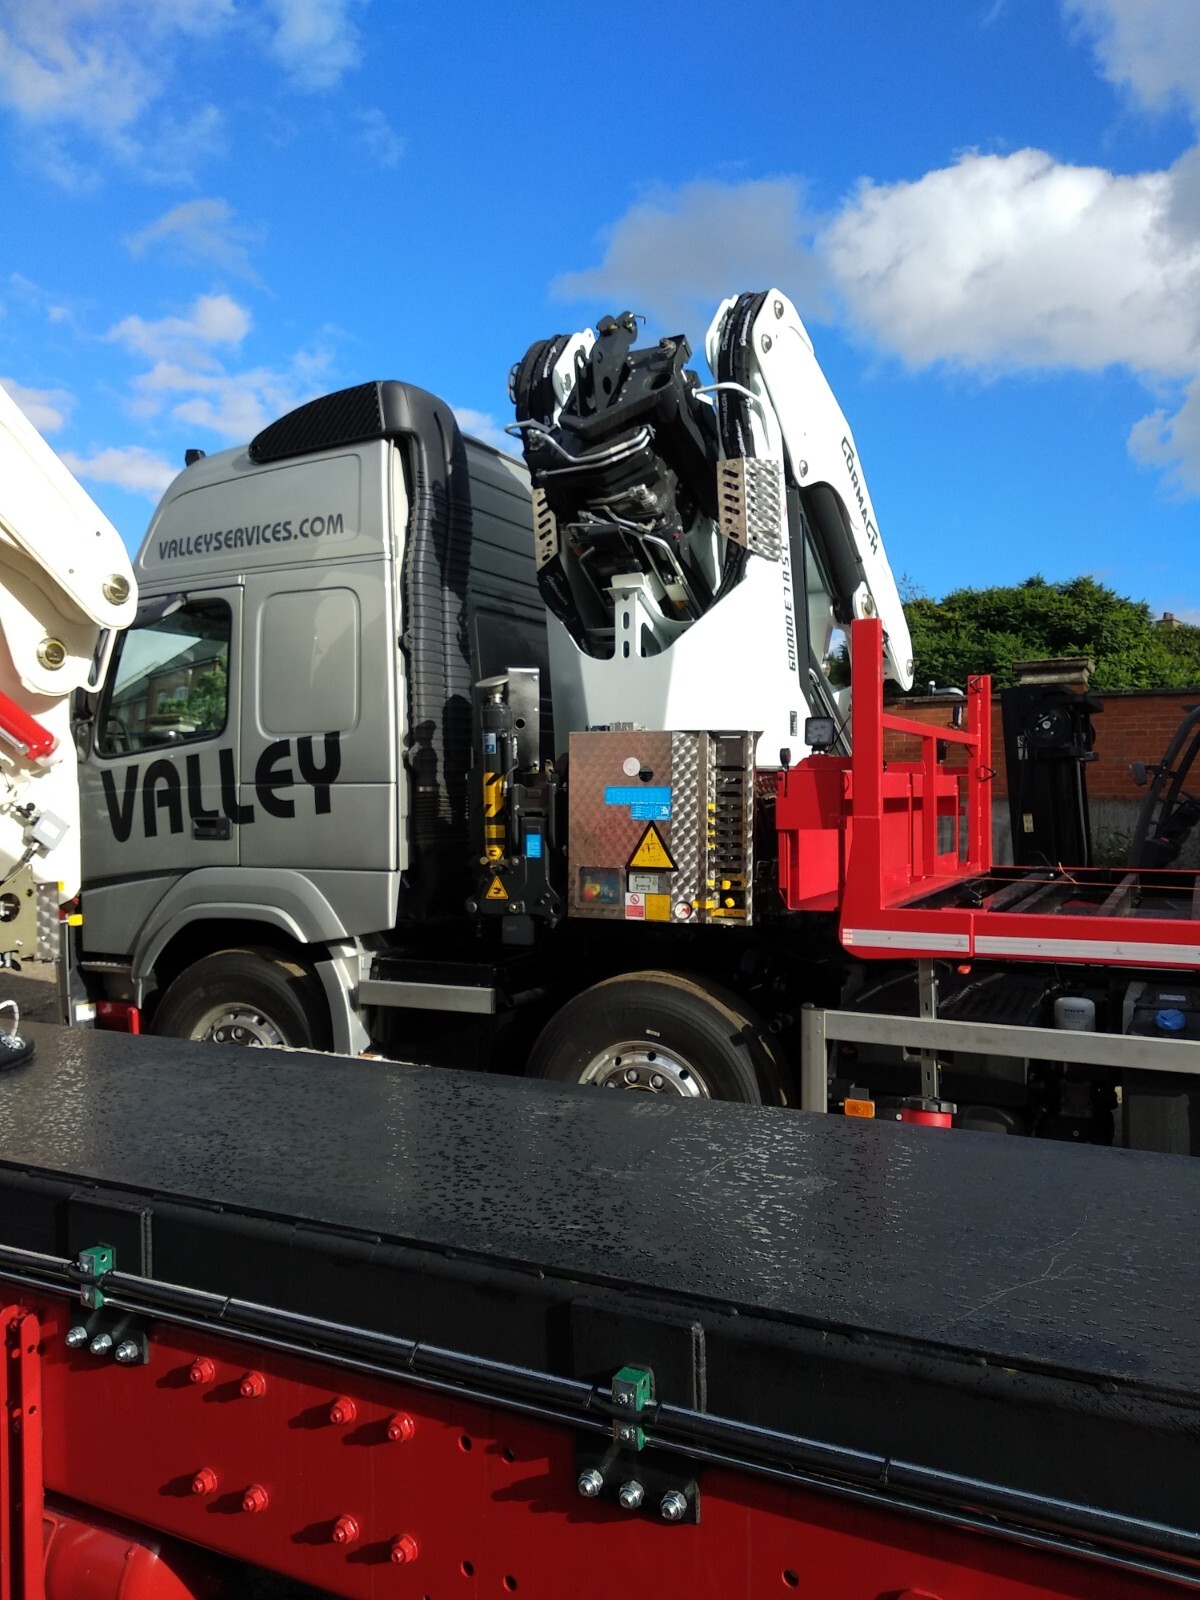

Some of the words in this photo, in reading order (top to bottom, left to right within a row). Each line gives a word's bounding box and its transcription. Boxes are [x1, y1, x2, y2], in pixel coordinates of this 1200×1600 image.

[158, 513, 344, 560] VALLEYSERVICES.COM
[841, 436, 878, 555] CORMACH
[100, 731, 342, 842] VALLEY
